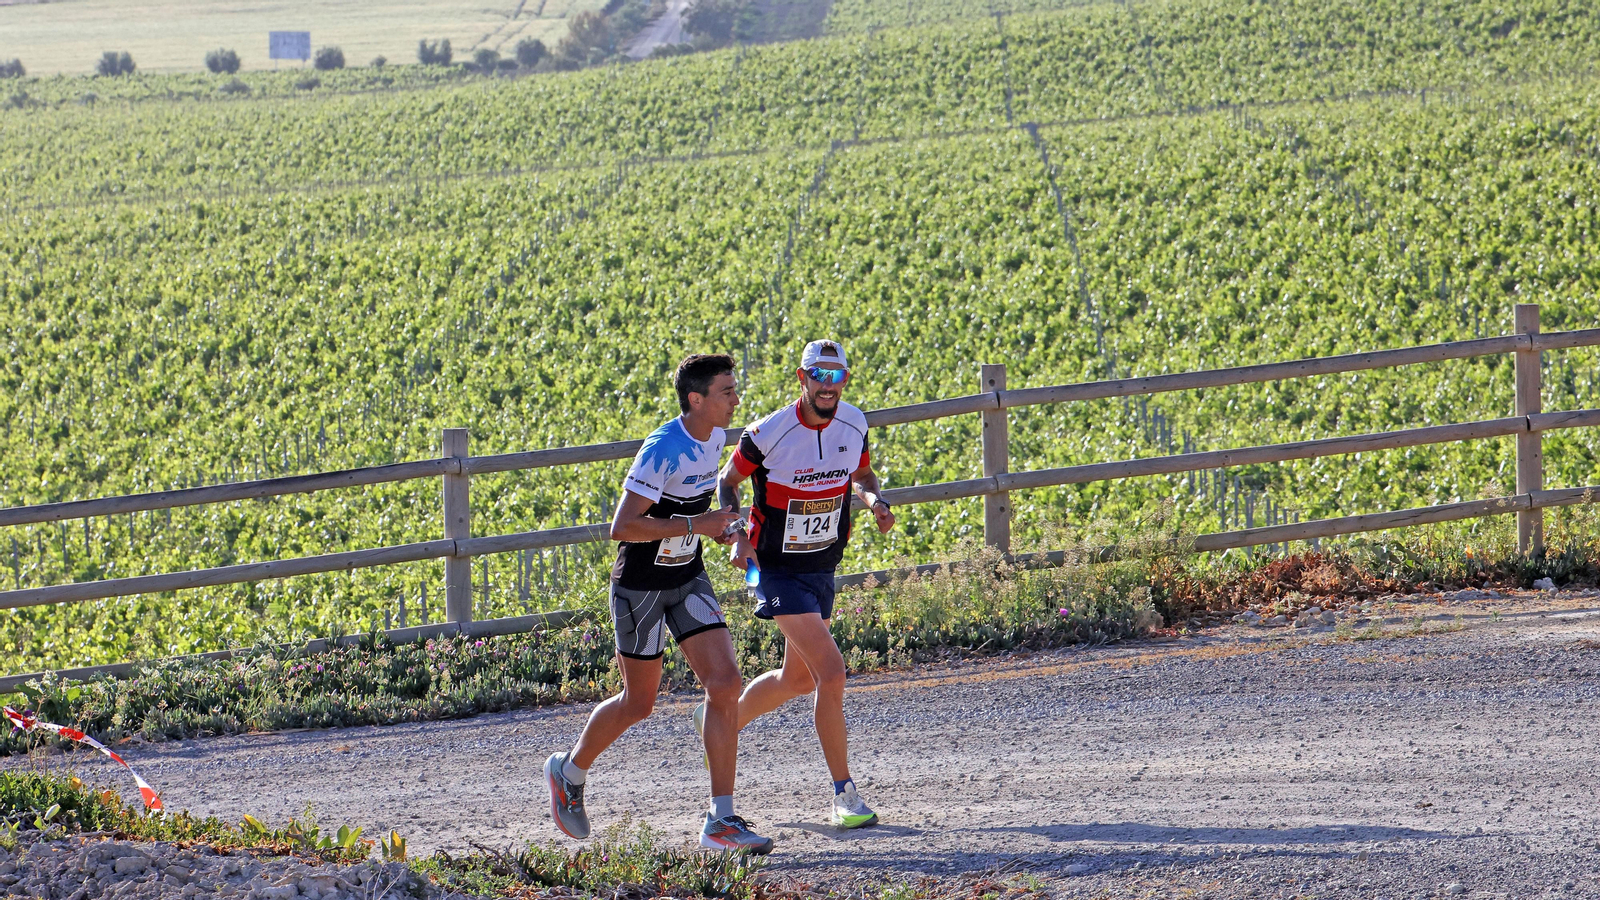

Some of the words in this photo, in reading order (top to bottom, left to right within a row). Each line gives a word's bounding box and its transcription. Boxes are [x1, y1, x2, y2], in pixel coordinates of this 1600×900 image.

[792, 468, 848, 483] HARMAN
[807, 501, 833, 510] Sherry
[803, 516, 830, 535] 124
